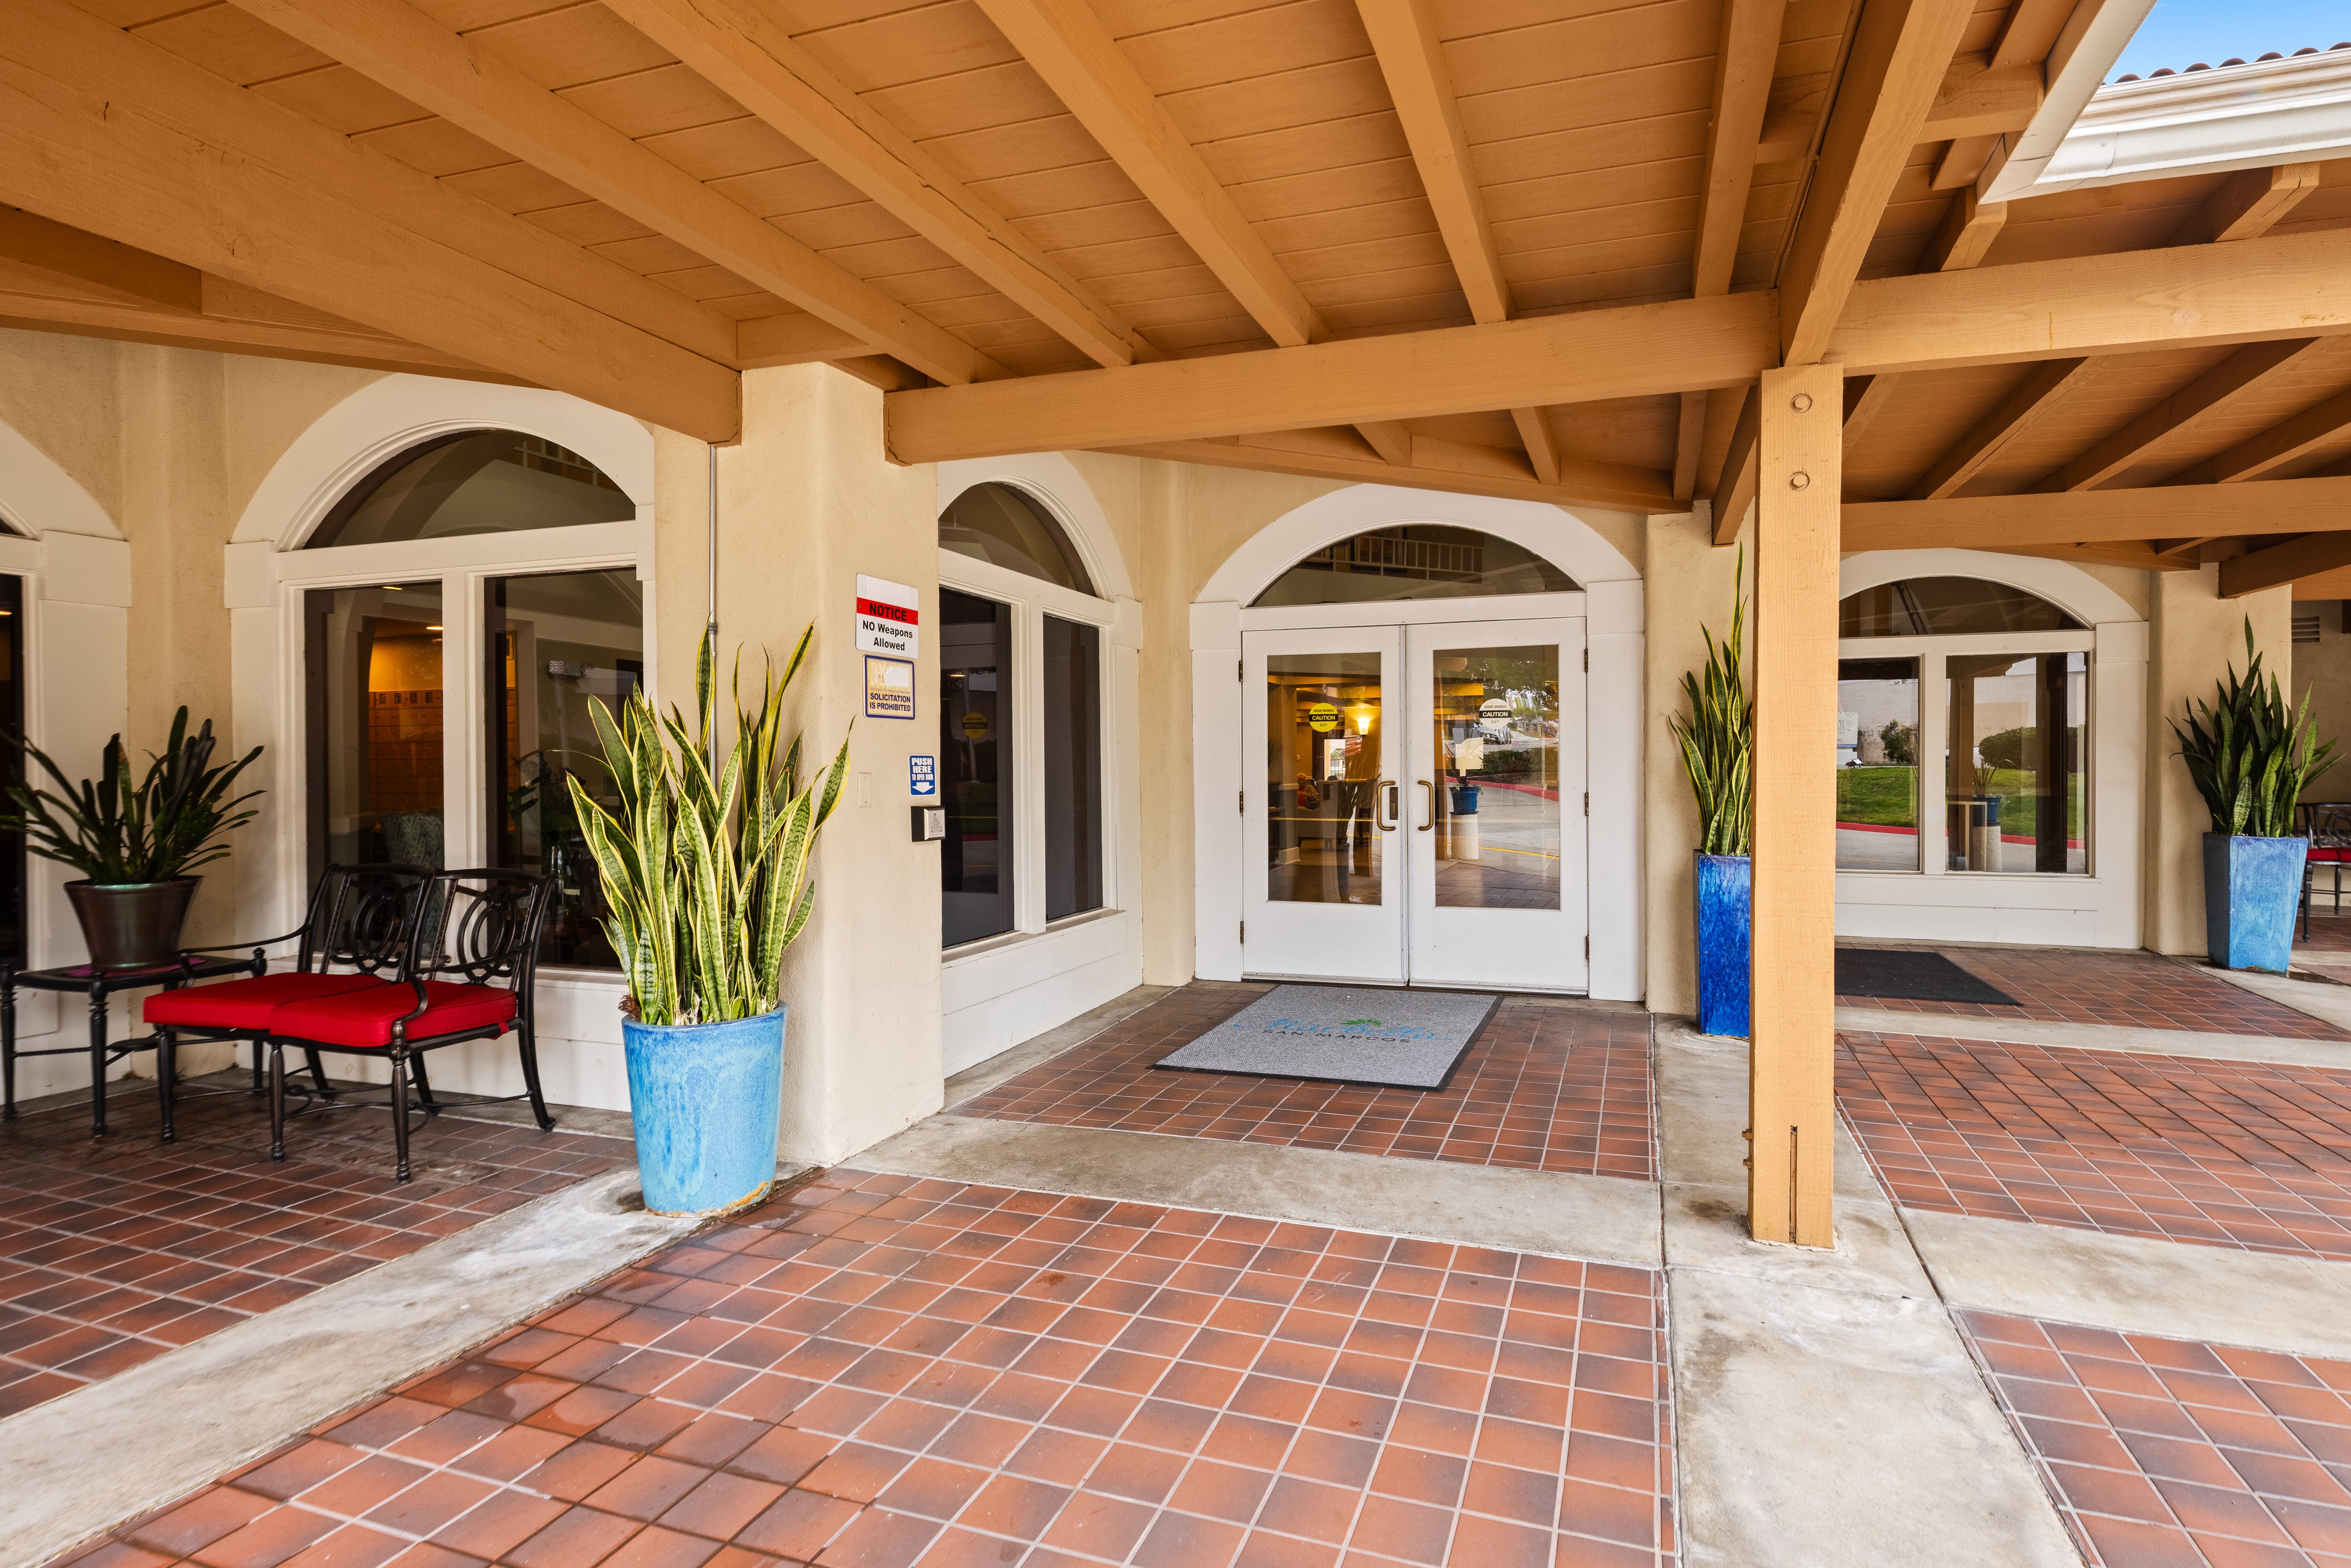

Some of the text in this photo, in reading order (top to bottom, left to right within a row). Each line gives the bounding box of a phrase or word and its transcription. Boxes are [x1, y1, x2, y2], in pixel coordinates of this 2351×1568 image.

[869, 602, 907, 621] NOTICE
[863, 620, 913, 638] NO Weapons
[873, 637, 905, 651] Allowed
[870, 693, 911, 703] SOLICITATION
[877, 702, 911, 711] PROHIBITED
[1316, 1033, 1411, 1043] MARCOS
